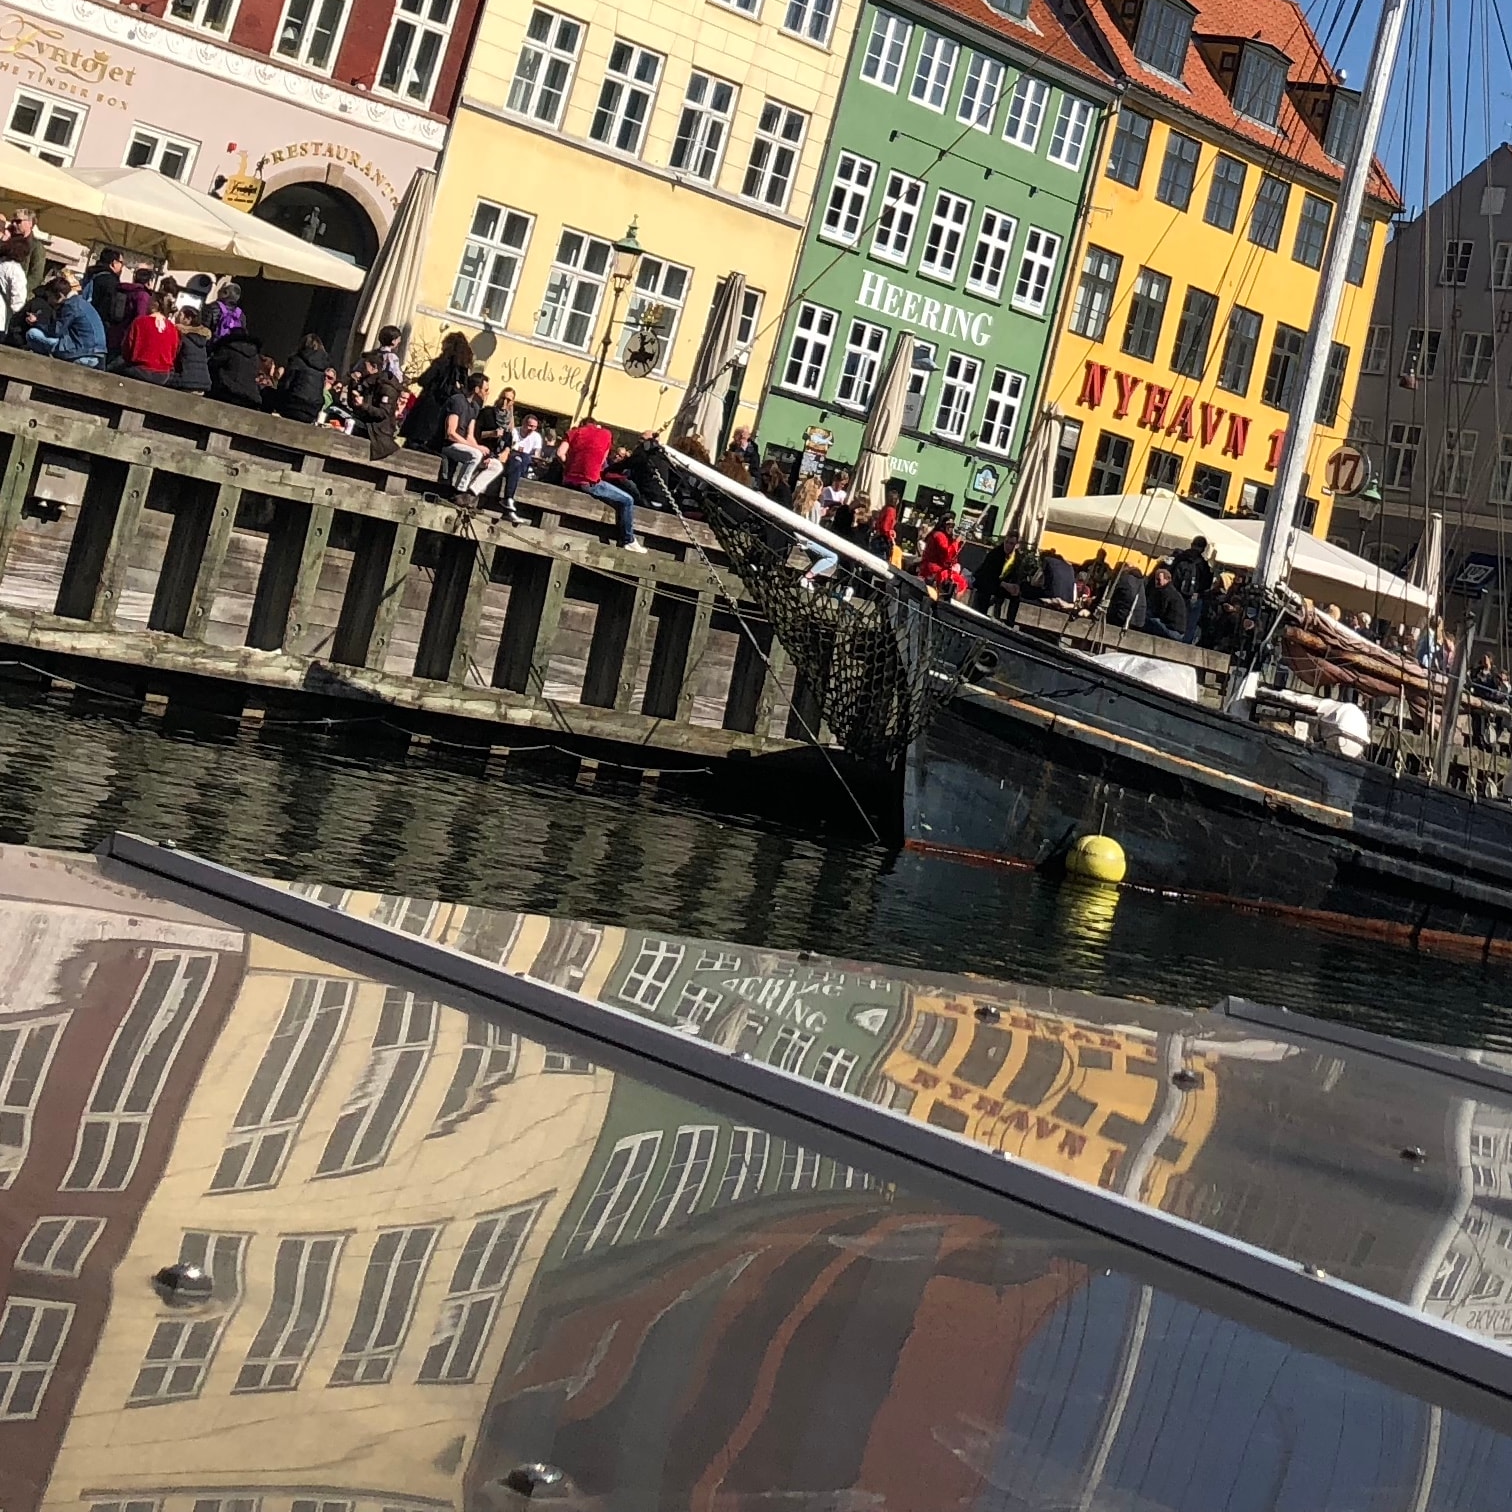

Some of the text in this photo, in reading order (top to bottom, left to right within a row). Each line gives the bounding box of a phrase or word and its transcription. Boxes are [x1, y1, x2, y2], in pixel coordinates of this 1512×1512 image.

[0, 61, 129, 110] HE TINDER BOX
[855, 269, 994, 347] HEERING
[501, 356, 556, 384] Klods
[1076, 360, 1287, 471] NYHAVN 1
[888, 455, 918, 476] RING
[1328, 452, 1361, 491] 17
